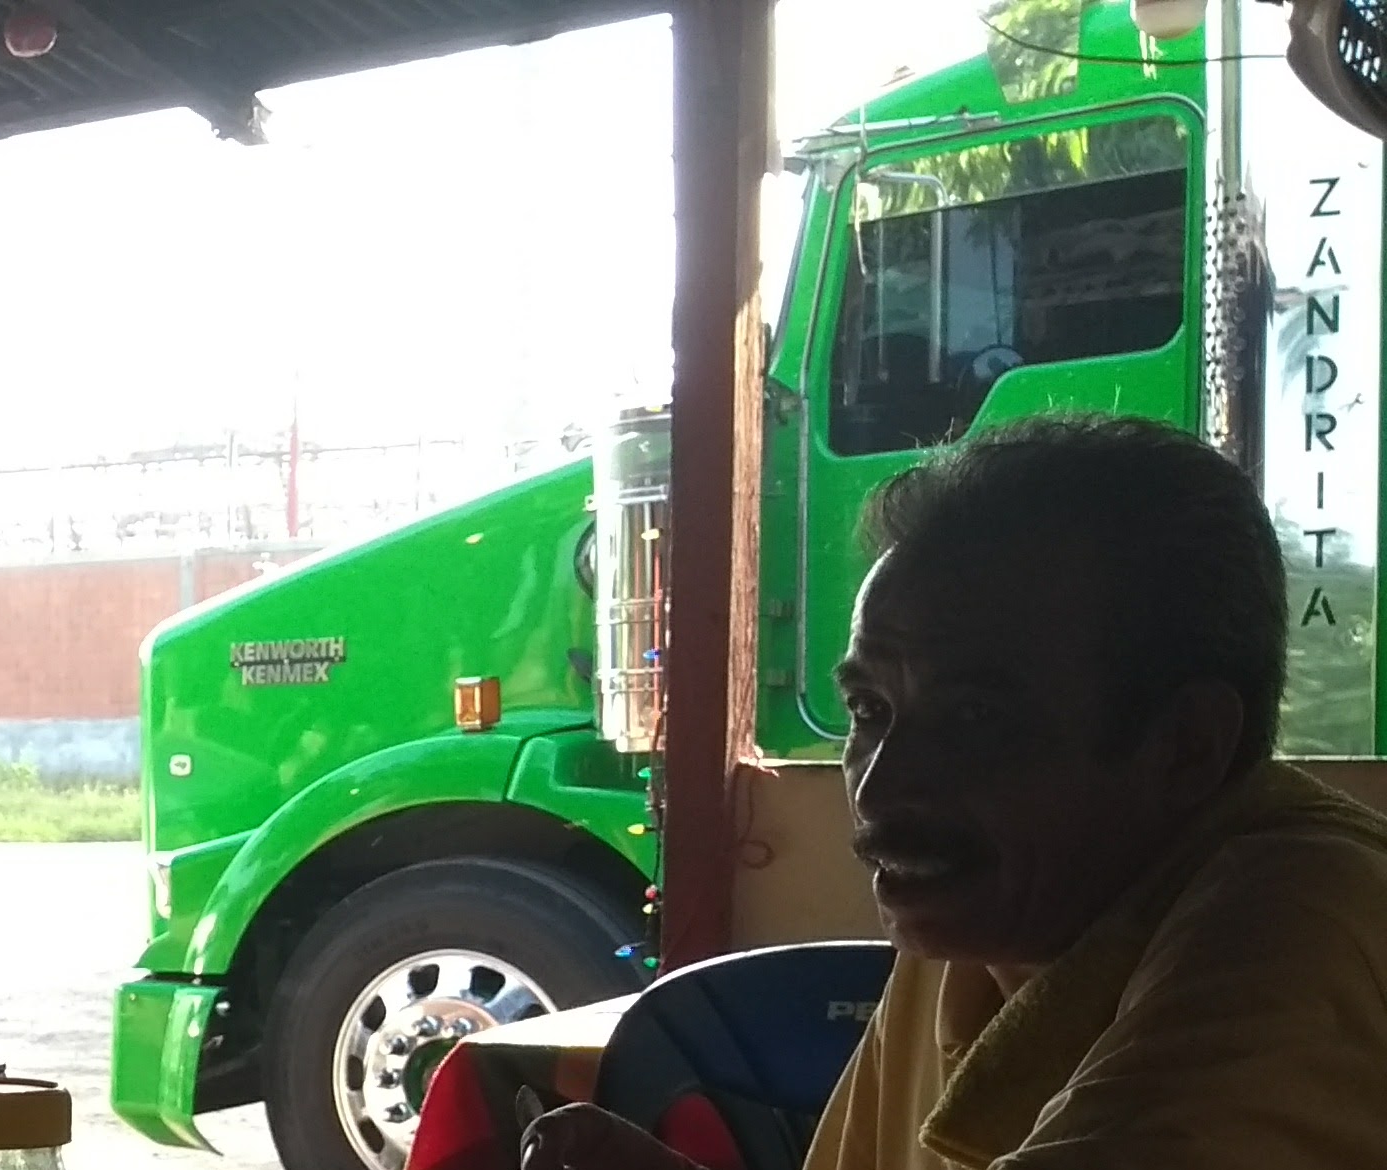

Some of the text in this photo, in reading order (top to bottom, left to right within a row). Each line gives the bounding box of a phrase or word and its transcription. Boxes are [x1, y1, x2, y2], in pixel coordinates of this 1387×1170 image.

[1300, 176, 1341, 627] ZANDRITA
[230, 636, 345, 663] KENWORTH
[242, 661, 329, 685] KENMEX
